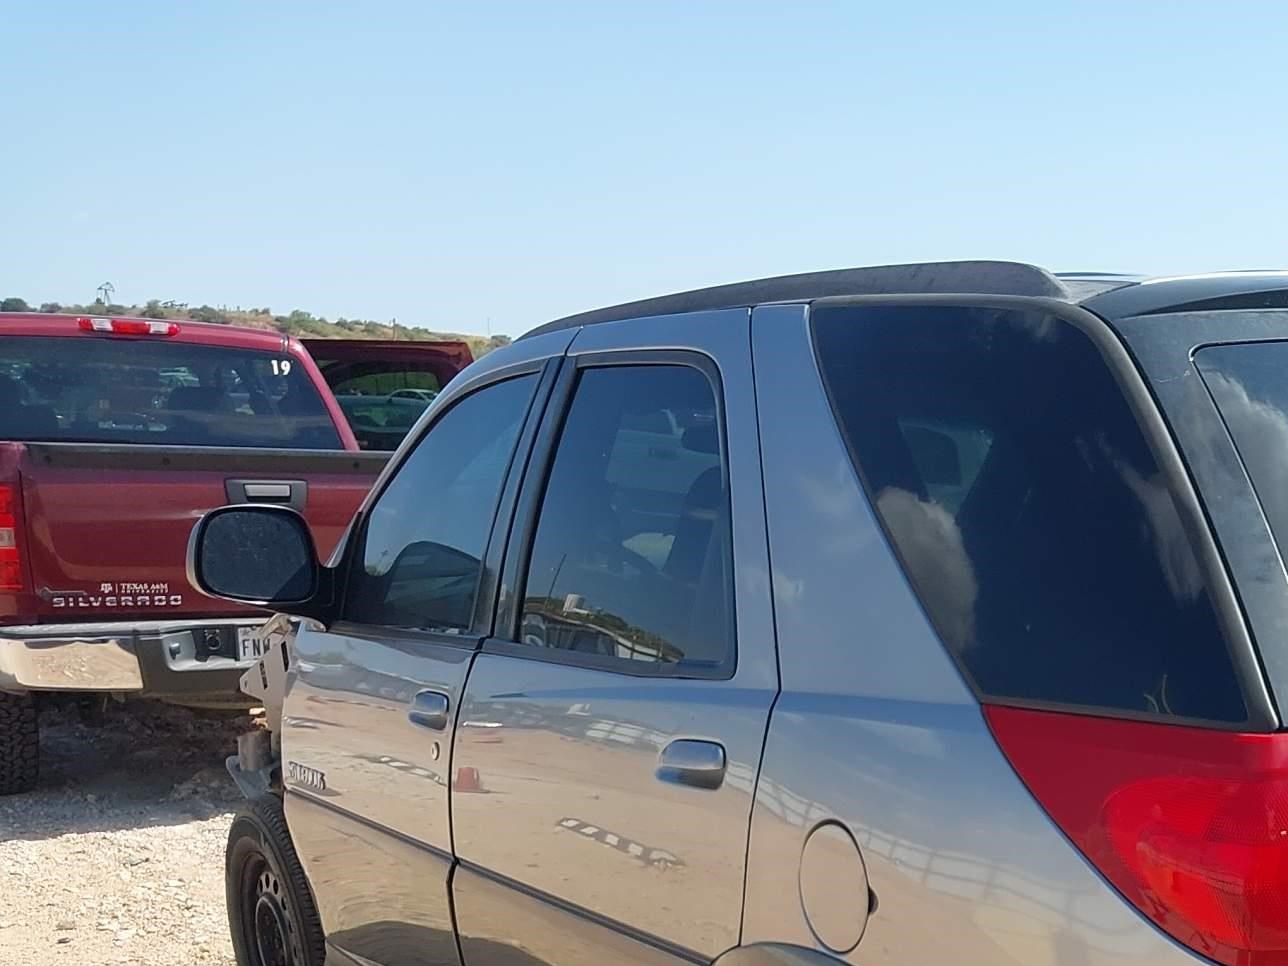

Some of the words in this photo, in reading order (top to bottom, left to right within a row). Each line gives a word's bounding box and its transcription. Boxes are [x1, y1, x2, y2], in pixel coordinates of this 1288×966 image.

[271, 359, 291, 376] 19
[121, 583, 149, 591] TEXAS
[150, 583, 169, 591] A&M
[52, 595, 182, 607] SILVERADO
